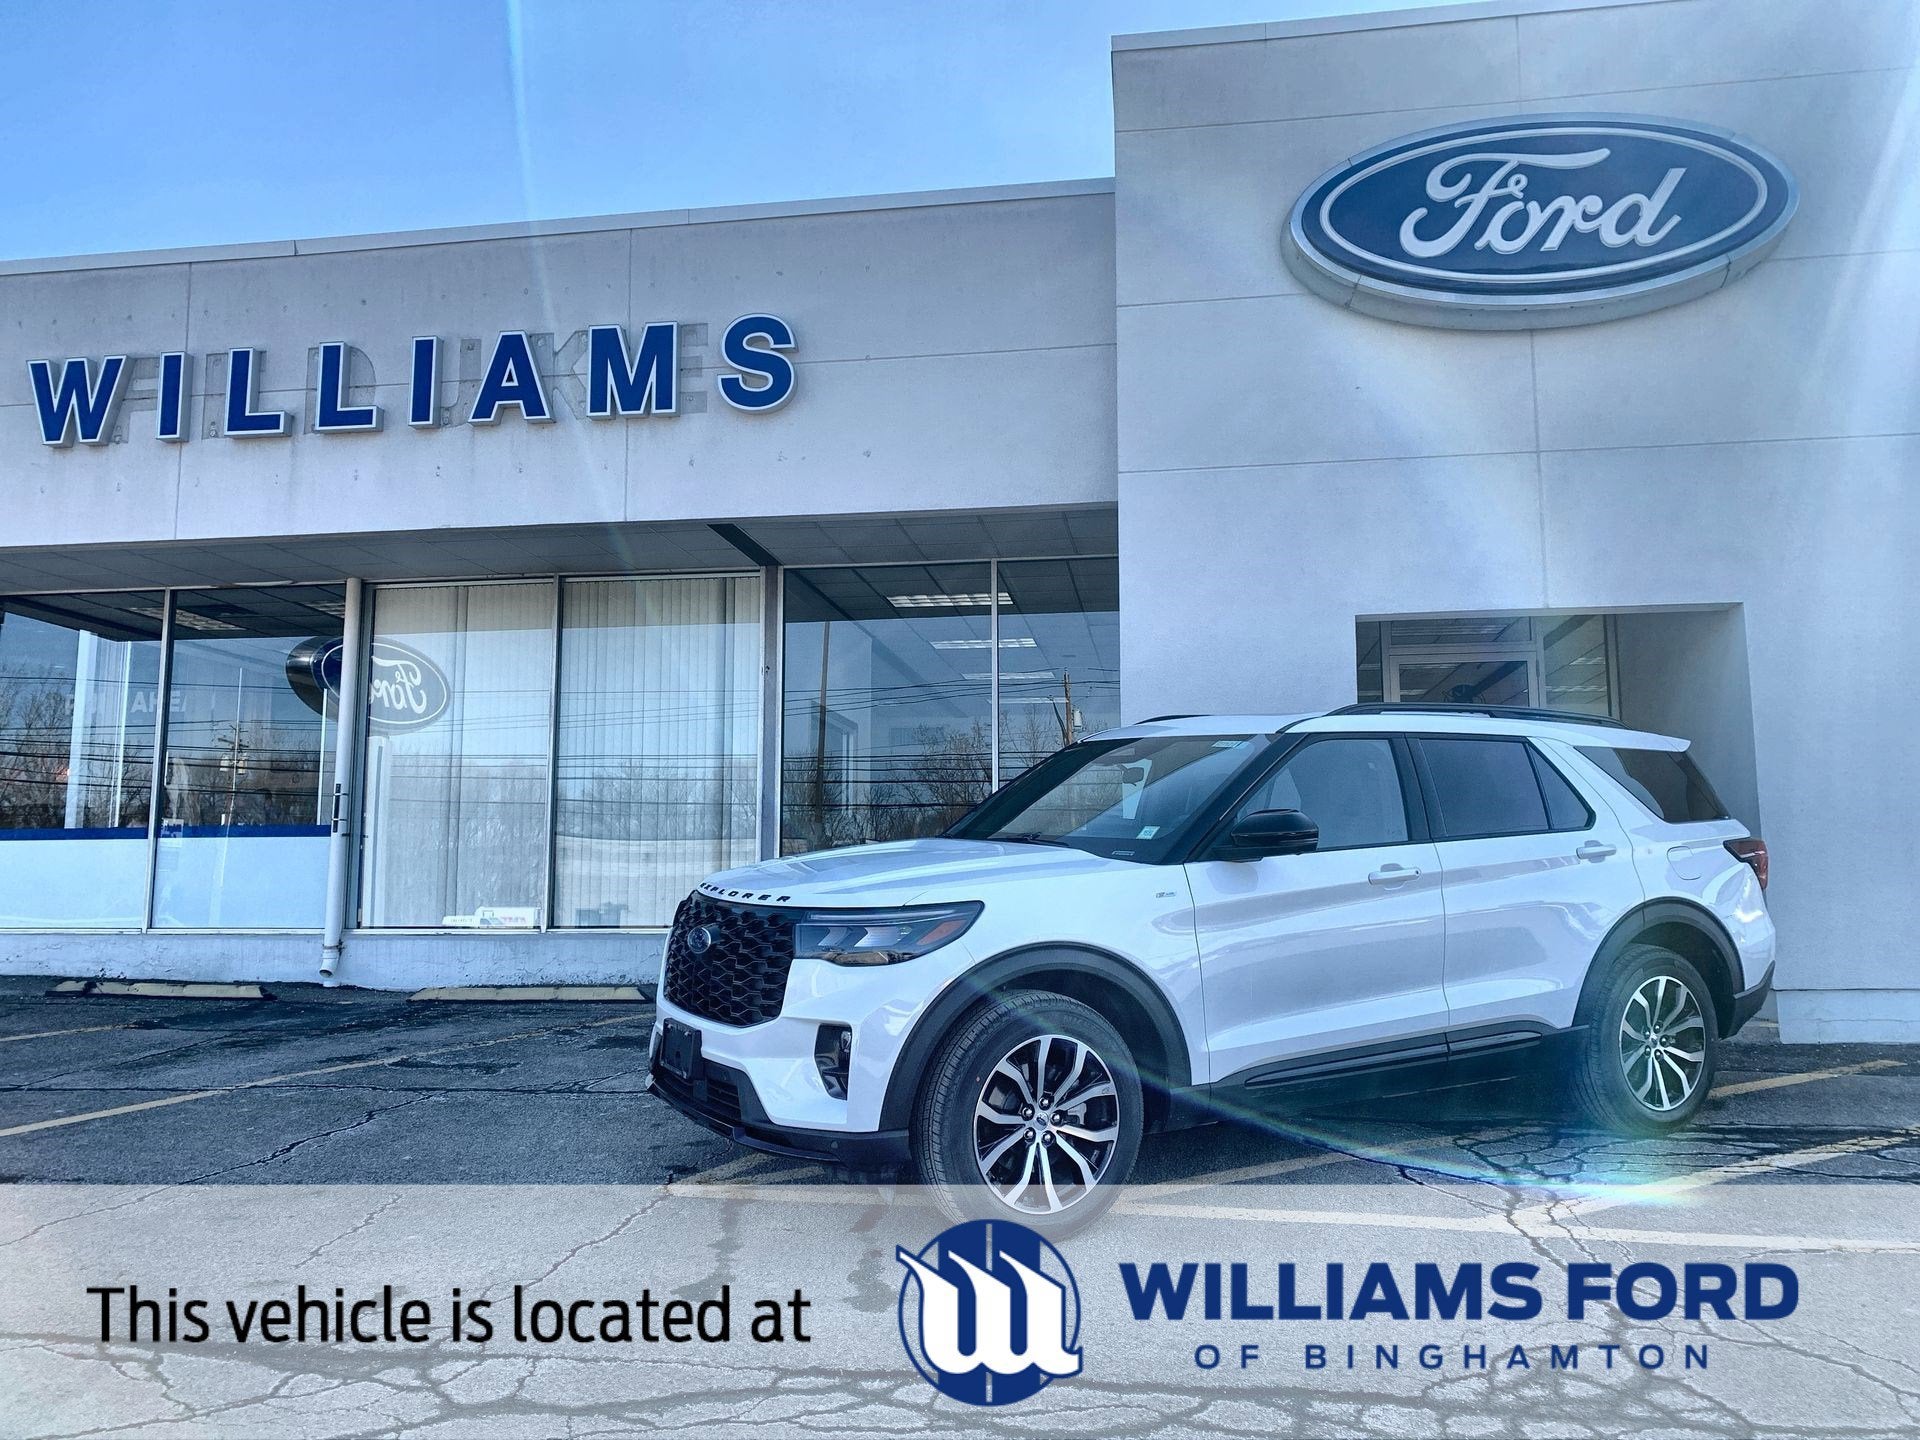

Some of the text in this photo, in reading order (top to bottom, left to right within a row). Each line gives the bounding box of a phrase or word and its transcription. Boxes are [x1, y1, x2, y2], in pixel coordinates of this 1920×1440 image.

[1400, 147, 1687, 258] Ford
[26, 312, 797, 449] WILLIAMS
[700, 882, 791, 902] EXPLORER
